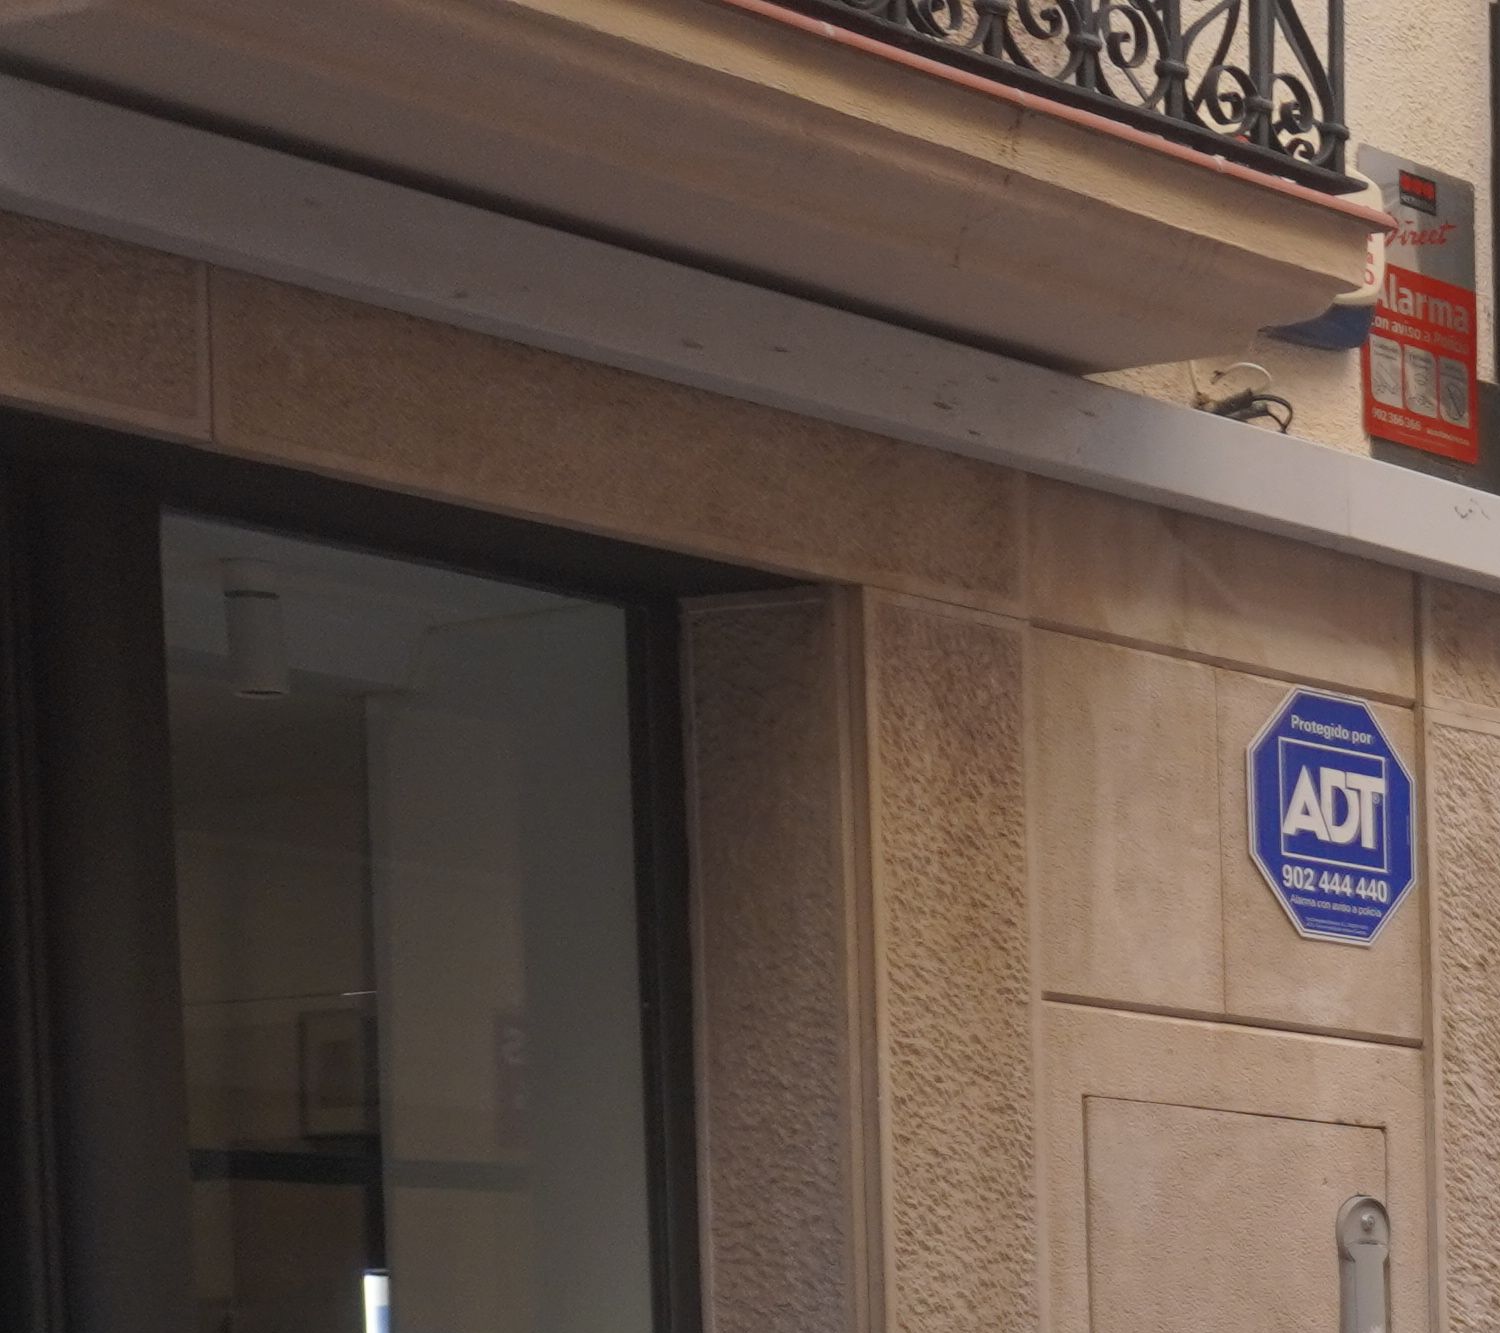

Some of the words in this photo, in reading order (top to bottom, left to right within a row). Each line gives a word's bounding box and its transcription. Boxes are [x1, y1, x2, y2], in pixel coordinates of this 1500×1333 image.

[1376, 272, 1470, 334] Alarma
[1371, 315, 1389, 331] on
[1391, 320, 1420, 340] aviso
[1291, 715, 1349, 740] Protegido
[1352, 728, 1373, 745] por
[1283, 765, 1386, 849] ADT
[1282, 864, 1315, 891] 902
[1319, 870, 1352, 898] 444
[1356, 877, 1389, 904] 440
